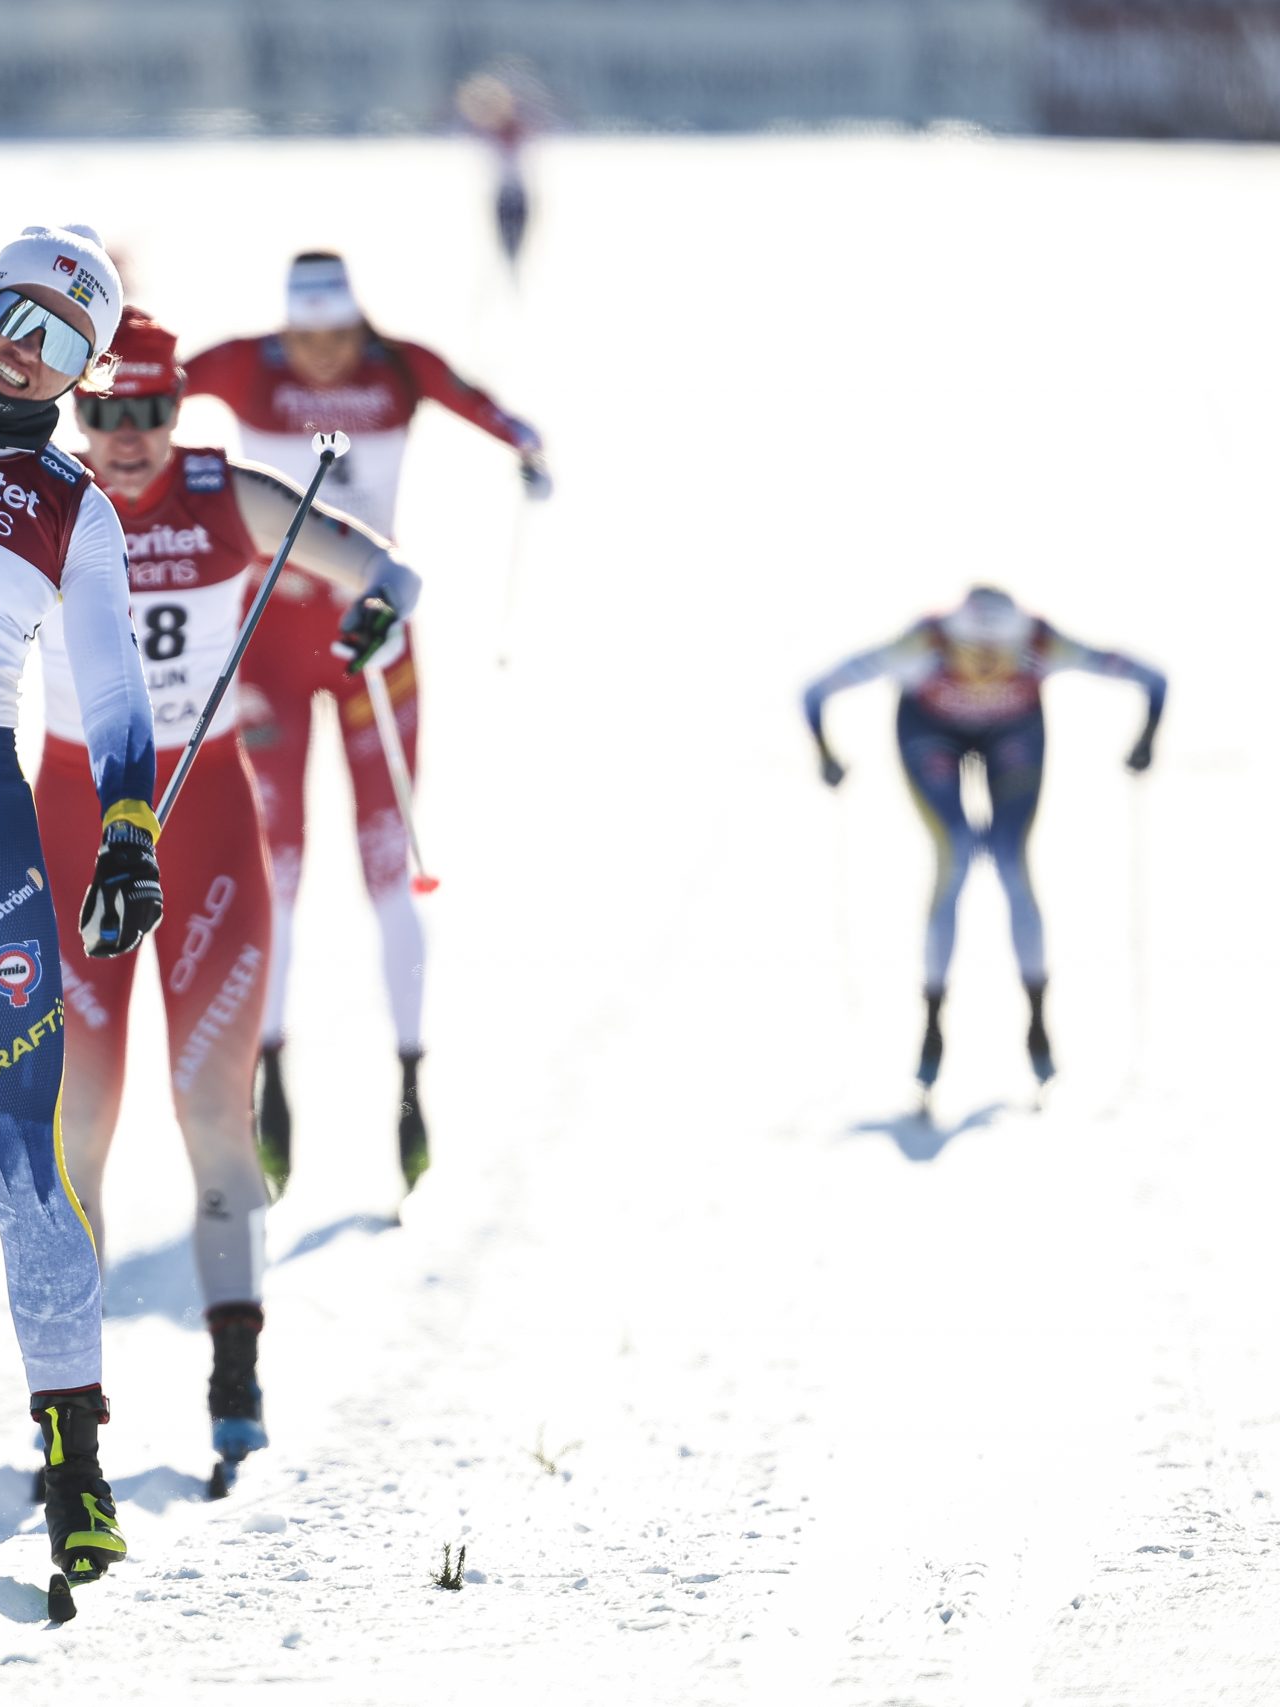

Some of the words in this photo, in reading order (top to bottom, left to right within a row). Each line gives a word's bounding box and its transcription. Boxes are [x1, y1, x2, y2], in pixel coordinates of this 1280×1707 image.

[77, 274, 95, 292] SPEL
[80, 268, 109, 305] SVENSKA
[124, 524, 213, 556] oritet
[144, 604, 188, 661] 8
